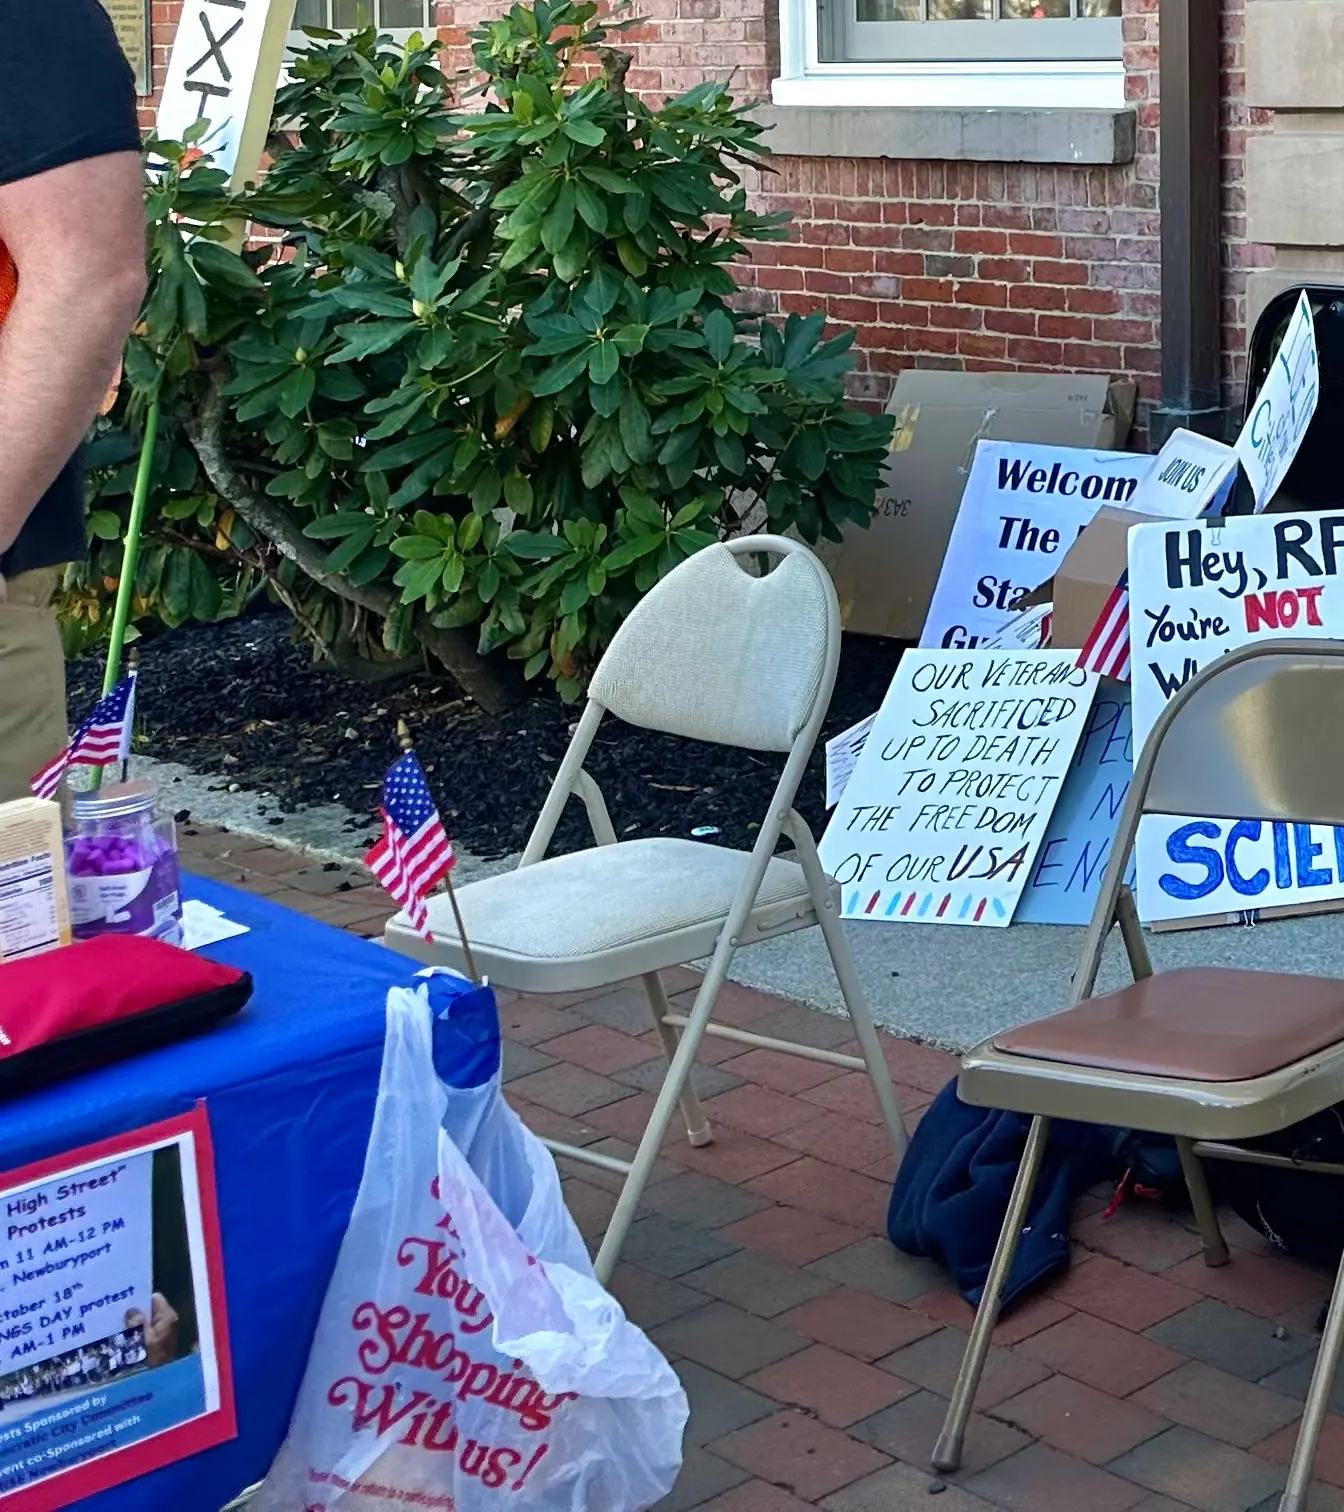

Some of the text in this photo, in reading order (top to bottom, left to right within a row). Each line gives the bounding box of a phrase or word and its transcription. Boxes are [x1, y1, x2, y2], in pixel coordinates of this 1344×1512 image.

[997, 458, 1137, 502] Welcom
[1158, 457, 1206, 493] JOIN US
[999, 516, 1060, 553] The
[1164, 529, 1268, 599] Hey,
[1144, 605, 1230, 648] You're
[1244, 586, 1326, 632] NOT
[912, 662, 974, 692] OUR
[912, 697, 1077, 730] SACRIFICED
[881, 735, 1060, 765] UP TO DEATH
[897, 768, 937, 797] TO
[939, 769, 1059, 805] PROTECT
[847, 804, 1037, 839] THE FREEDOM
[834, 853, 883, 884] OF
[886, 854, 947, 883] OUR
[946, 842, 1030, 882] USA
[6, 1192, 48, 1218] High
[7, 1205, 87, 1240] Protests
[15, 1217, 125, 1264] 11 AM-12 PM
[12, 1241, 112, 1287] Newburyport
[39, 1306, 73, 1330] DAY
[79, 1285, 135, 1318] protest
[10, 1322, 86, 1360] AM-1 PM
[24, 1400, 91, 1433] Sponsored
[92, 1395, 108, 1408] by
[51, 1423, 77, 1438] City
[27, 1425, 113, 1464] co-Sponsored
[114, 1415, 140, 1431] with
[459, 1440, 549, 1492] us!
